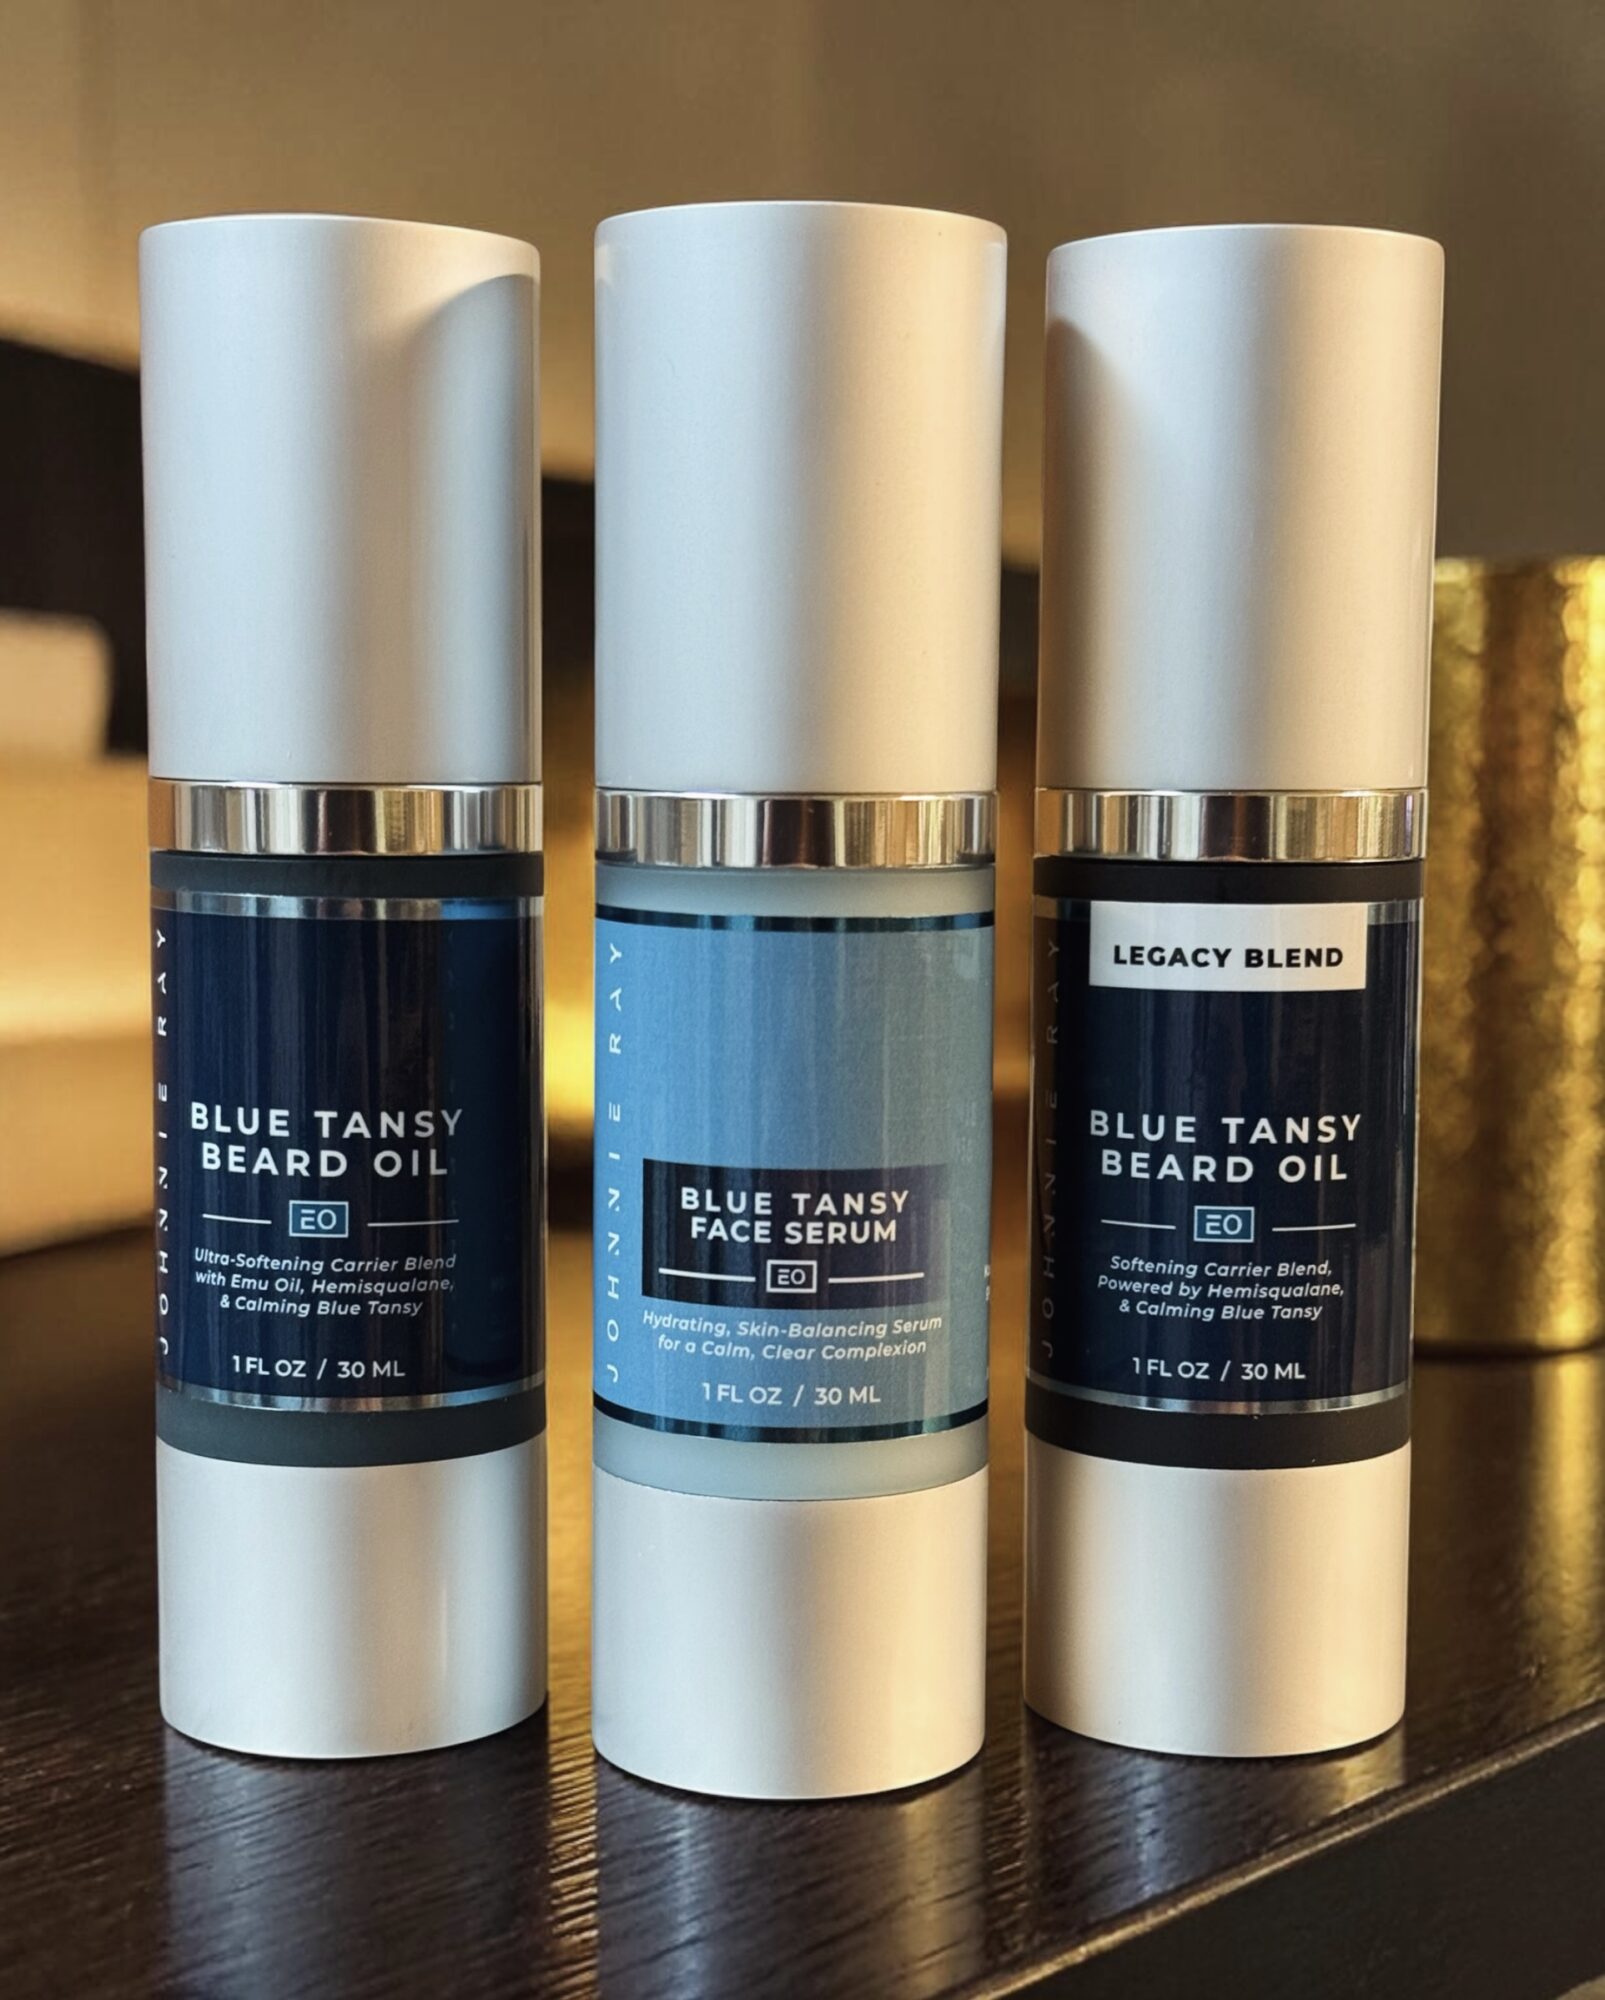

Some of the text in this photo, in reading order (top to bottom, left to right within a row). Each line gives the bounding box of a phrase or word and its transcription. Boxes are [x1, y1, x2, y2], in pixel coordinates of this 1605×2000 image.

[1113, 944, 1344, 969] LEGACY BLEND
[191, 1102, 462, 1139] BLUE TANSY
[1090, 1109, 1361, 1144] BLUE TANSY
[156, 929, 169, 1356] JOHNNIE RAY
[202, 1142, 448, 1178] BEARD OIL
[606, 943, 623, 1384] JOHNNIE RAY
[1101, 1149, 1348, 1183] BEARD OIL
[681, 1187, 909, 1216] BLUE TANSY
[300, 1208, 337, 1230] EO
[691, 1216, 897, 1244] FACE SERUM
[1205, 1214, 1243, 1235] EO
[194, 1247, 456, 1275] Ultra-Softening Carrier Blend
[1110, 1255, 1332, 1279] Softening Carrier Blend,
[195, 1270, 454, 1296] with Emu Oil, Hemisqualane,
[777, 1268, 806, 1285] EO
[1097, 1274, 1345, 1300] Powered by Hemisqualane,
[220, 1294, 423, 1318] & Calming Blue Tansy
[1119, 1299, 1323, 1322] & Calming Blue Tansy
[643, 1310, 943, 1339] Hydrating, Skin-Balancing Serum
[658, 1334, 927, 1361] for a Calm, Clear Complexion
[232, 1355, 406, 1380] 1 FL OZ / 30 ML
[1132, 1357, 1306, 1382] 1 FL OZ / 30 ML
[702, 1383, 881, 1407] 1 FL OZ / 30 ML
